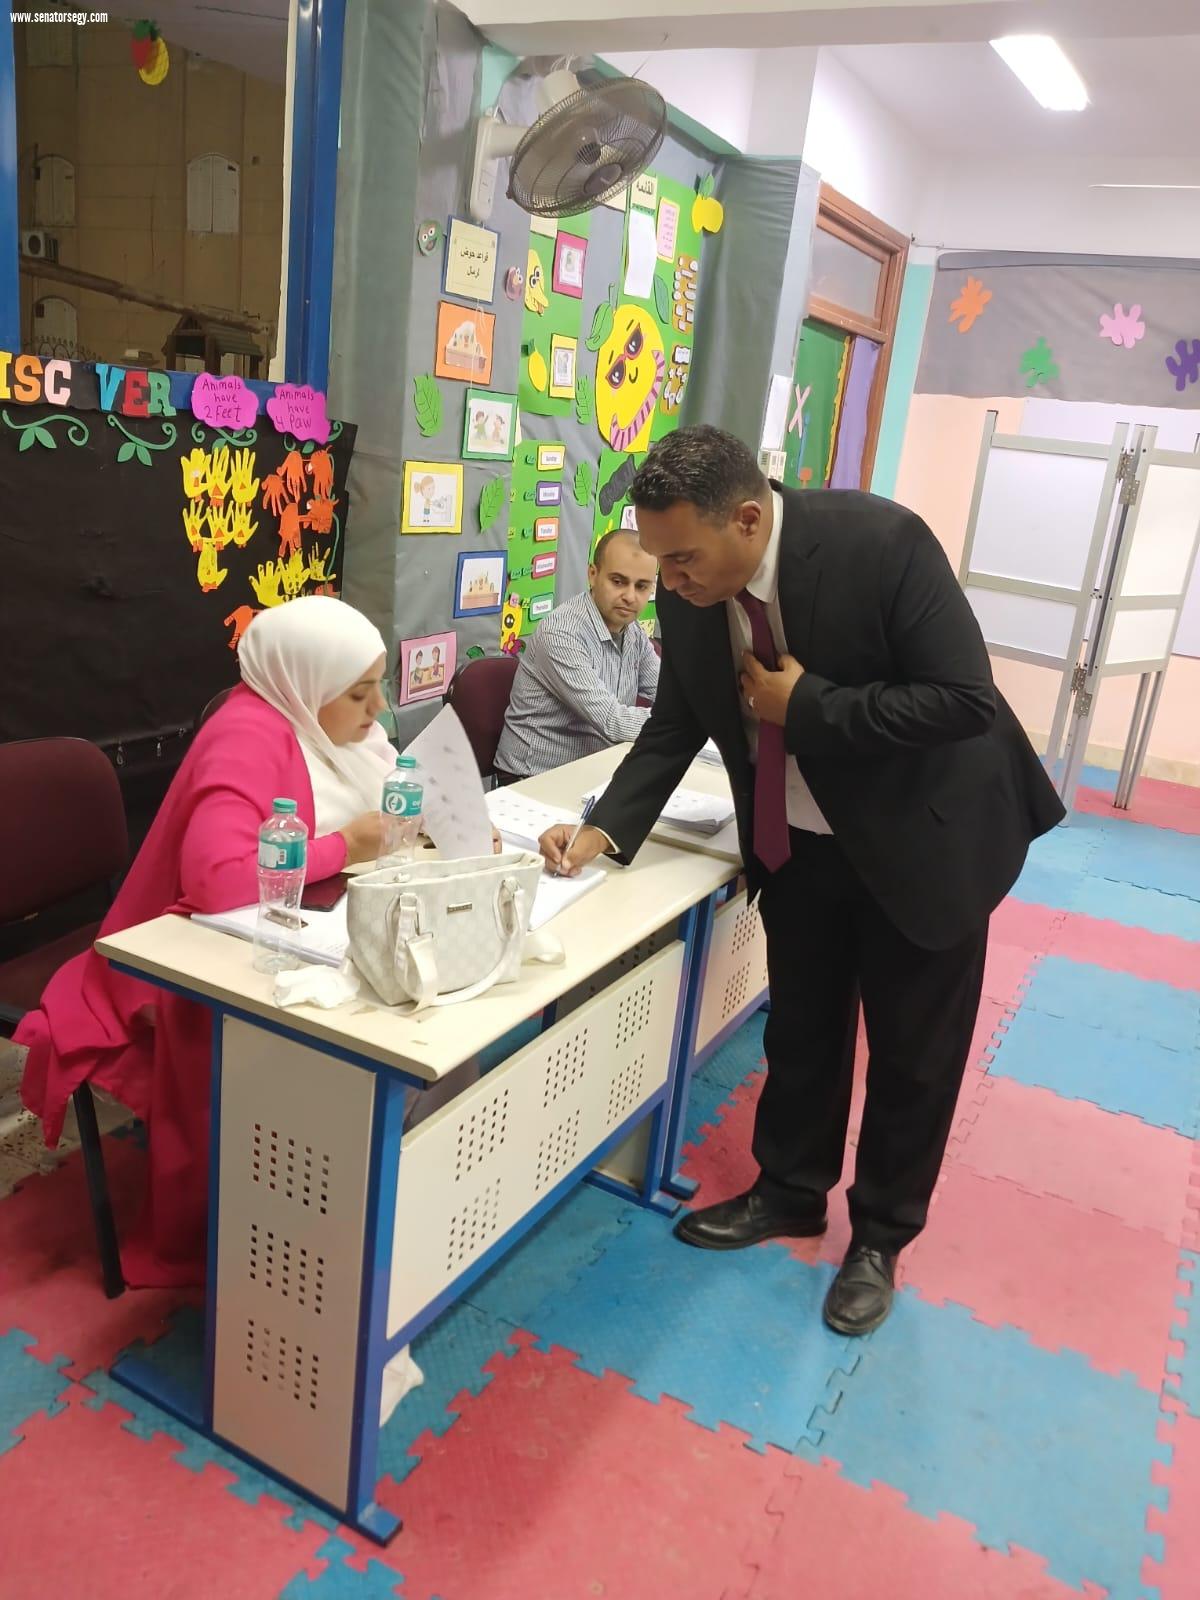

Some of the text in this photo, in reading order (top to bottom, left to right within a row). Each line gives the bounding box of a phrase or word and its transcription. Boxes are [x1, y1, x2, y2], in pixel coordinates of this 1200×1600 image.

[202, 379, 241, 391] Animals
[213, 392, 238, 404] have
[279, 389, 314, 401] Animals
[203, 405, 213, 419] 2
[287, 401, 311, 415] have
[275, 415, 285, 430] 4
